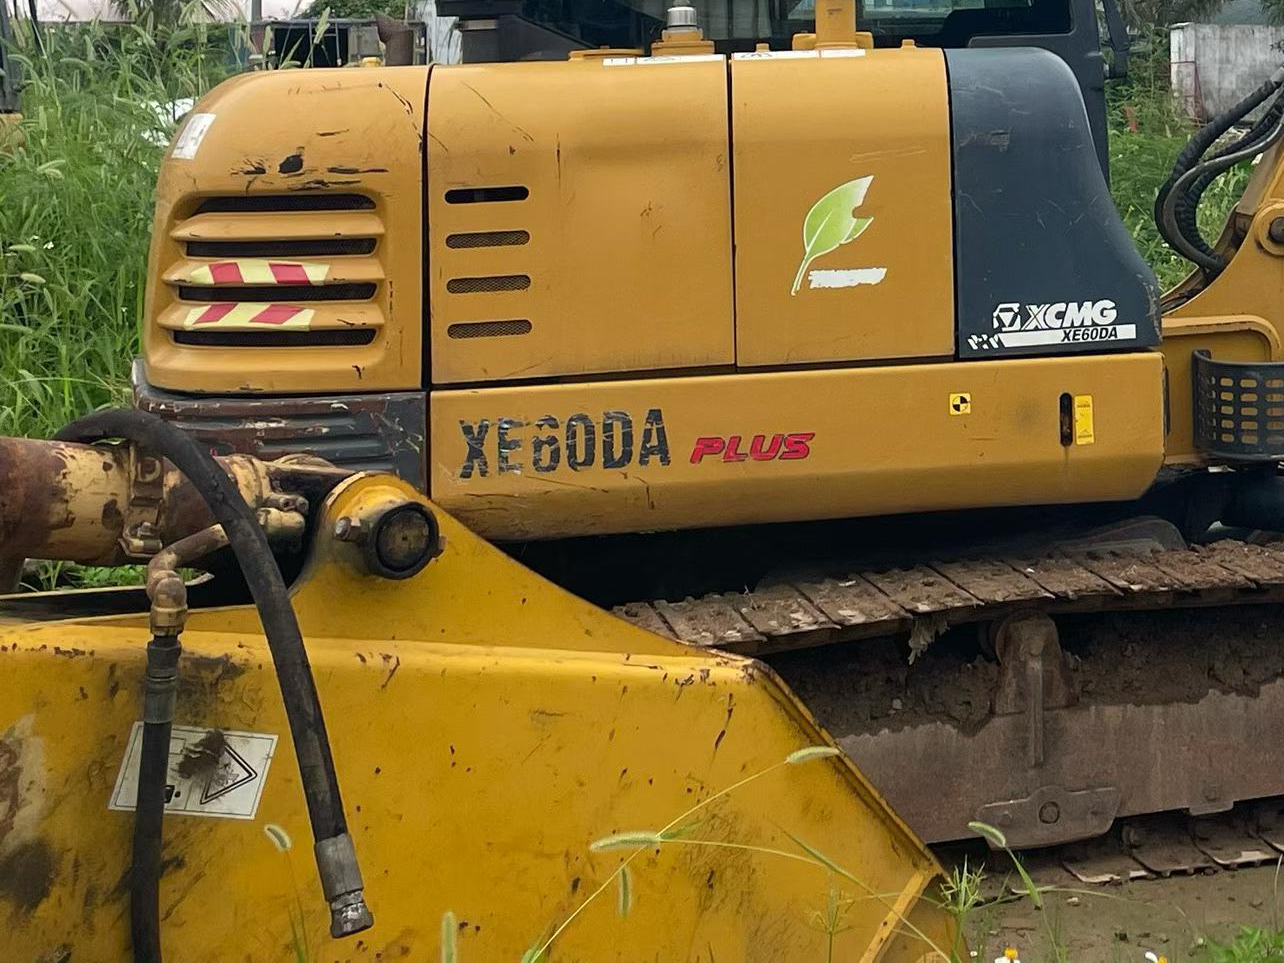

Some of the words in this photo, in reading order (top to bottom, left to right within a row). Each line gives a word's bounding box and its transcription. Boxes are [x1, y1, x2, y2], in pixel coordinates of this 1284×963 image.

[1021, 300, 1117, 330] XCMG
[1061, 327, 1119, 342] XE60DA
[459, 408, 672, 479] XE60DA
[689, 432, 816, 465] PLUS
